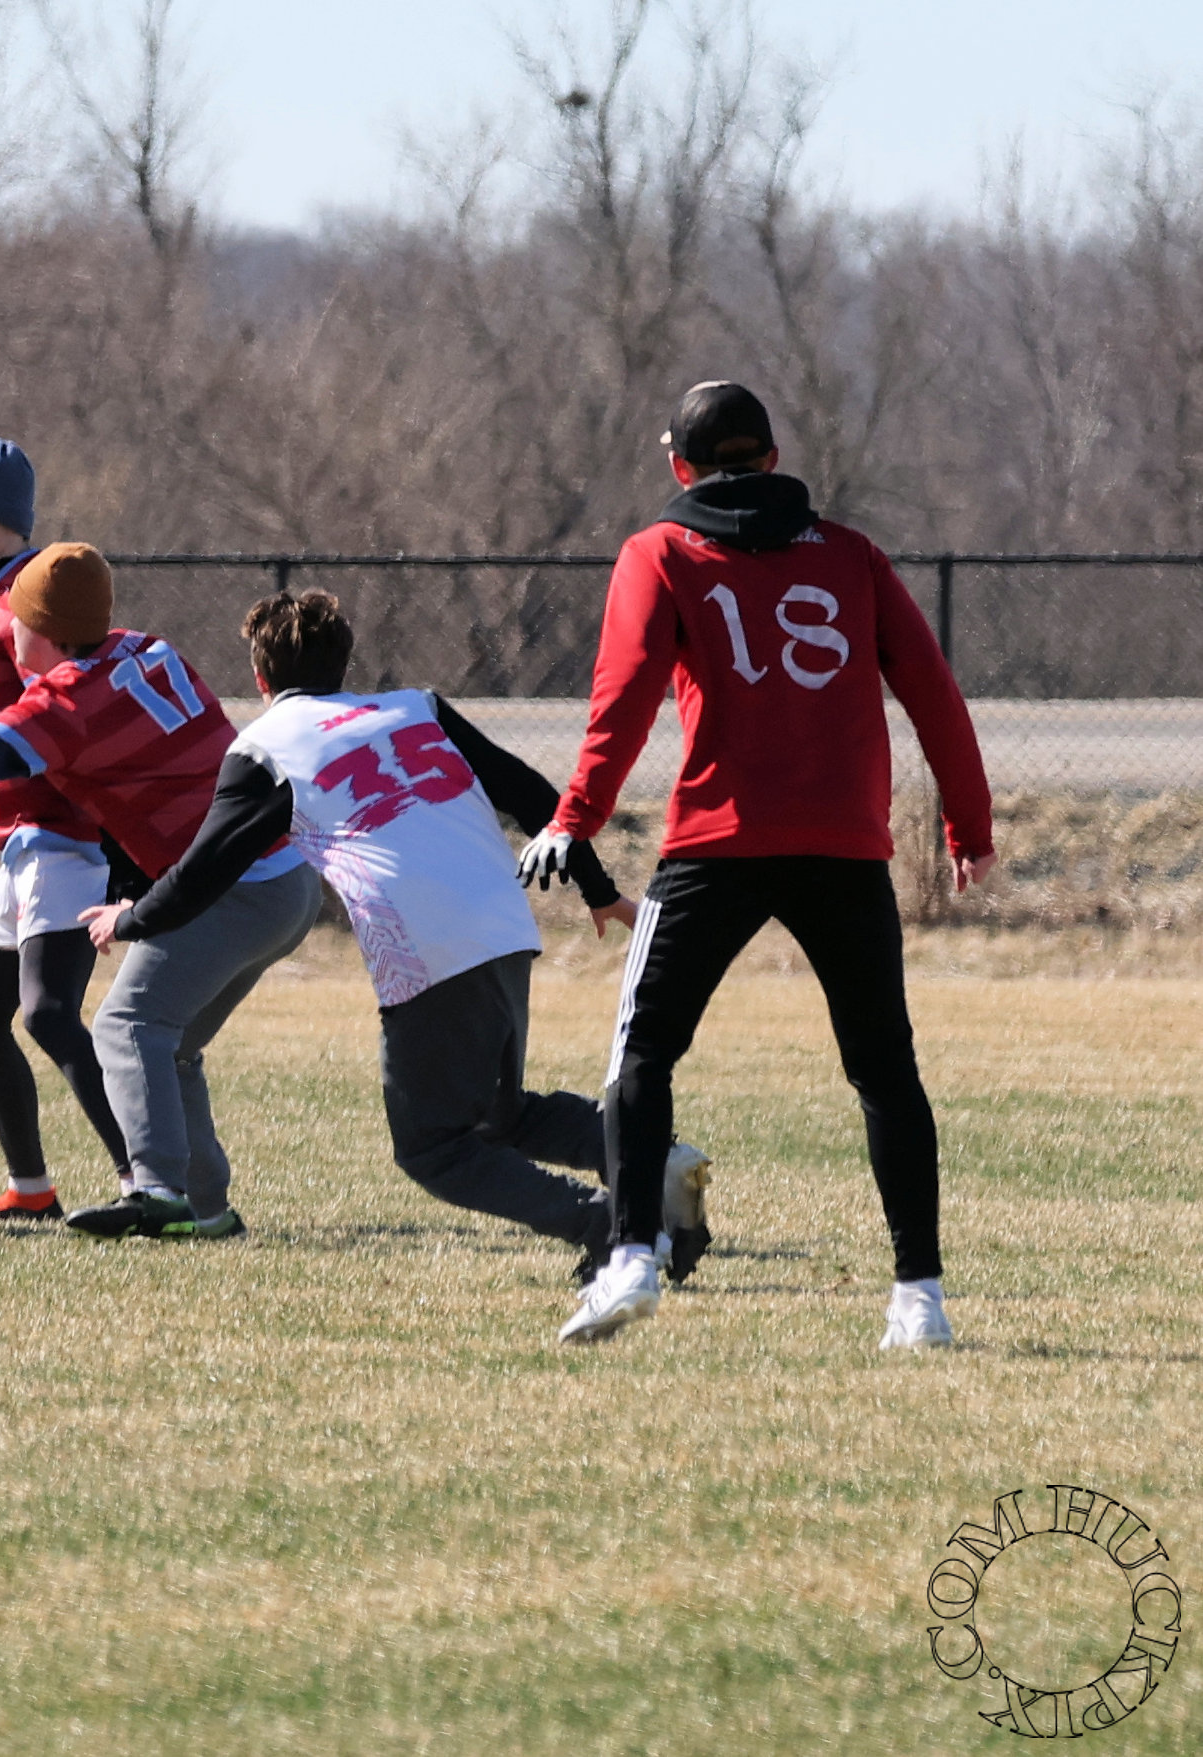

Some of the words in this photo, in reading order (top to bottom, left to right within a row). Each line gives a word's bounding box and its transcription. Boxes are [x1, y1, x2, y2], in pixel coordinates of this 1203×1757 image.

[108, 640, 205, 735] 17
[703, 583, 849, 689] 18
[312, 722, 474, 837] 35
